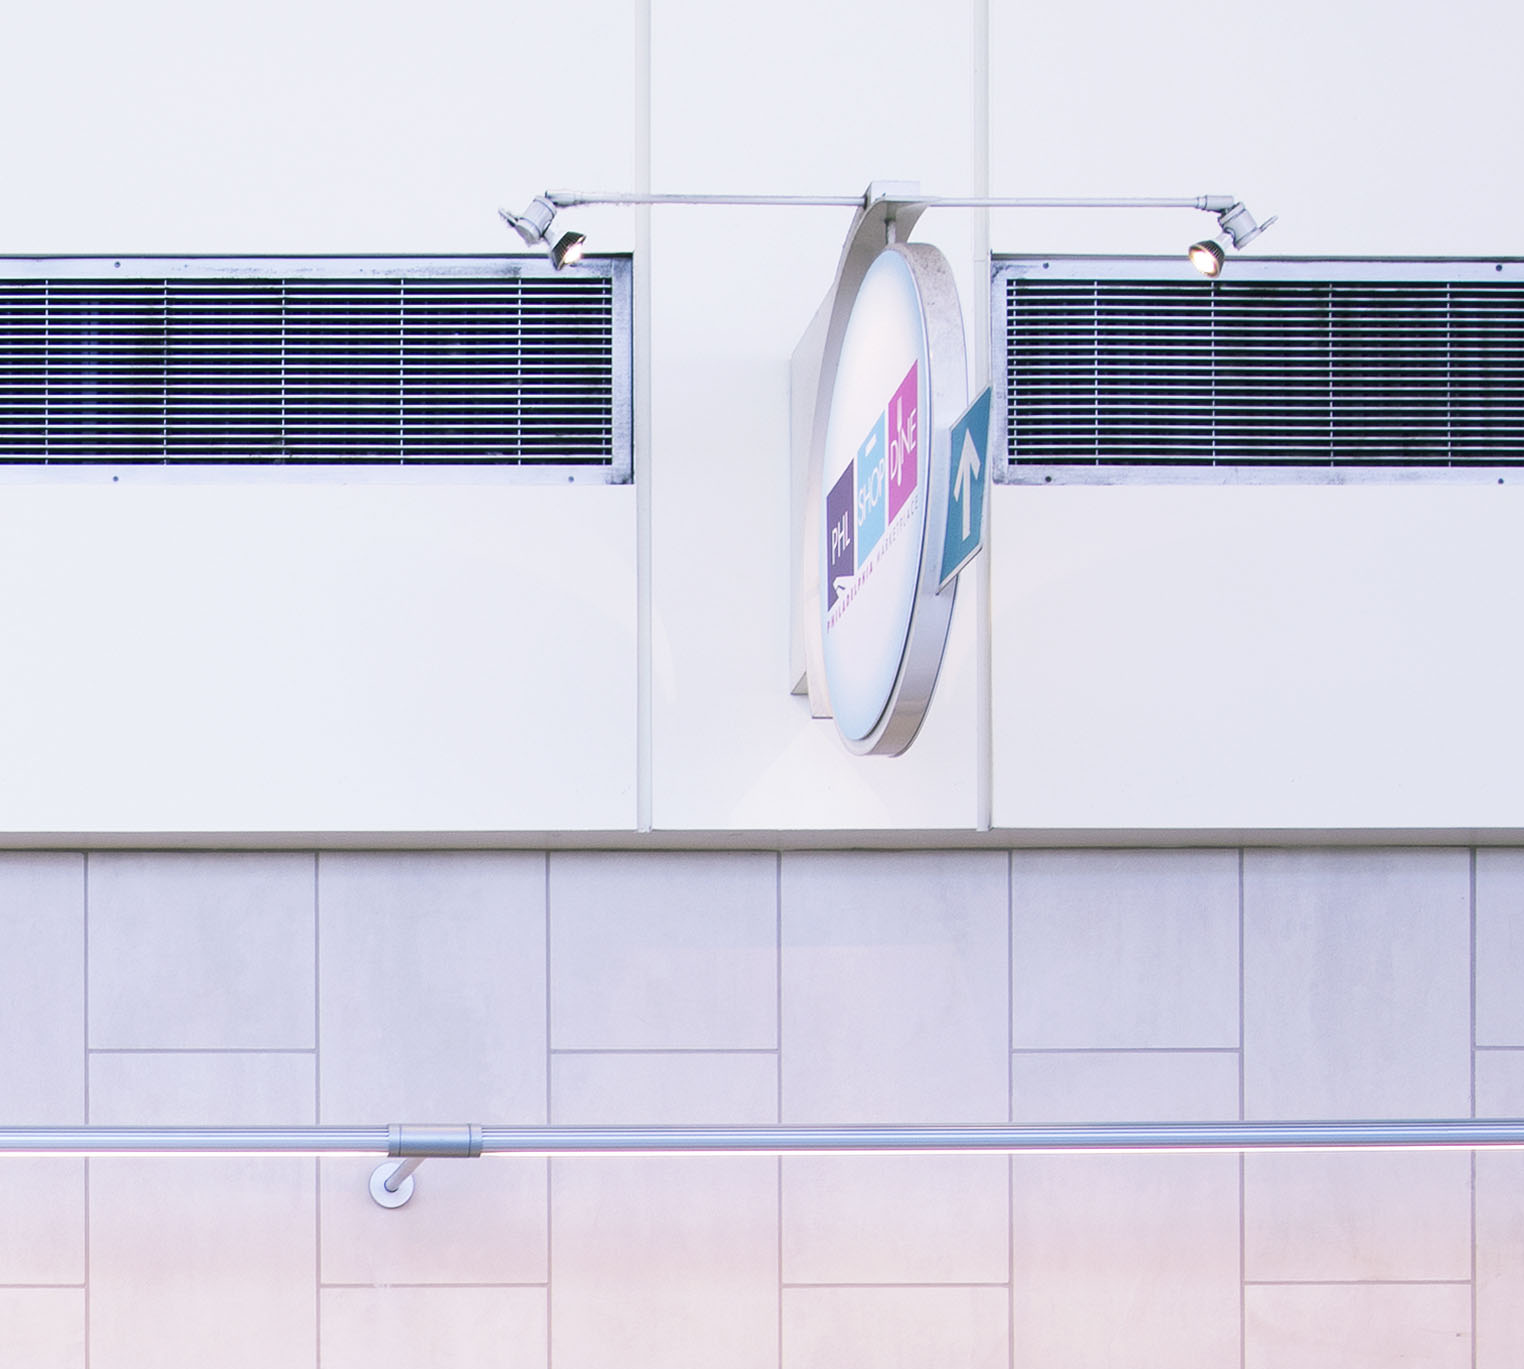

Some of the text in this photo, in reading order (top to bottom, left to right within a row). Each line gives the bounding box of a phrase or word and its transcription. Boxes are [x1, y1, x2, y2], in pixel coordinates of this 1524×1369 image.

[890, 399, 917, 487] DINE
[858, 458, 884, 527] SHOP
[826, 493, 920, 634] PHILADELPHIA MARKETPLACE
[832, 511, 850, 566] PHL
